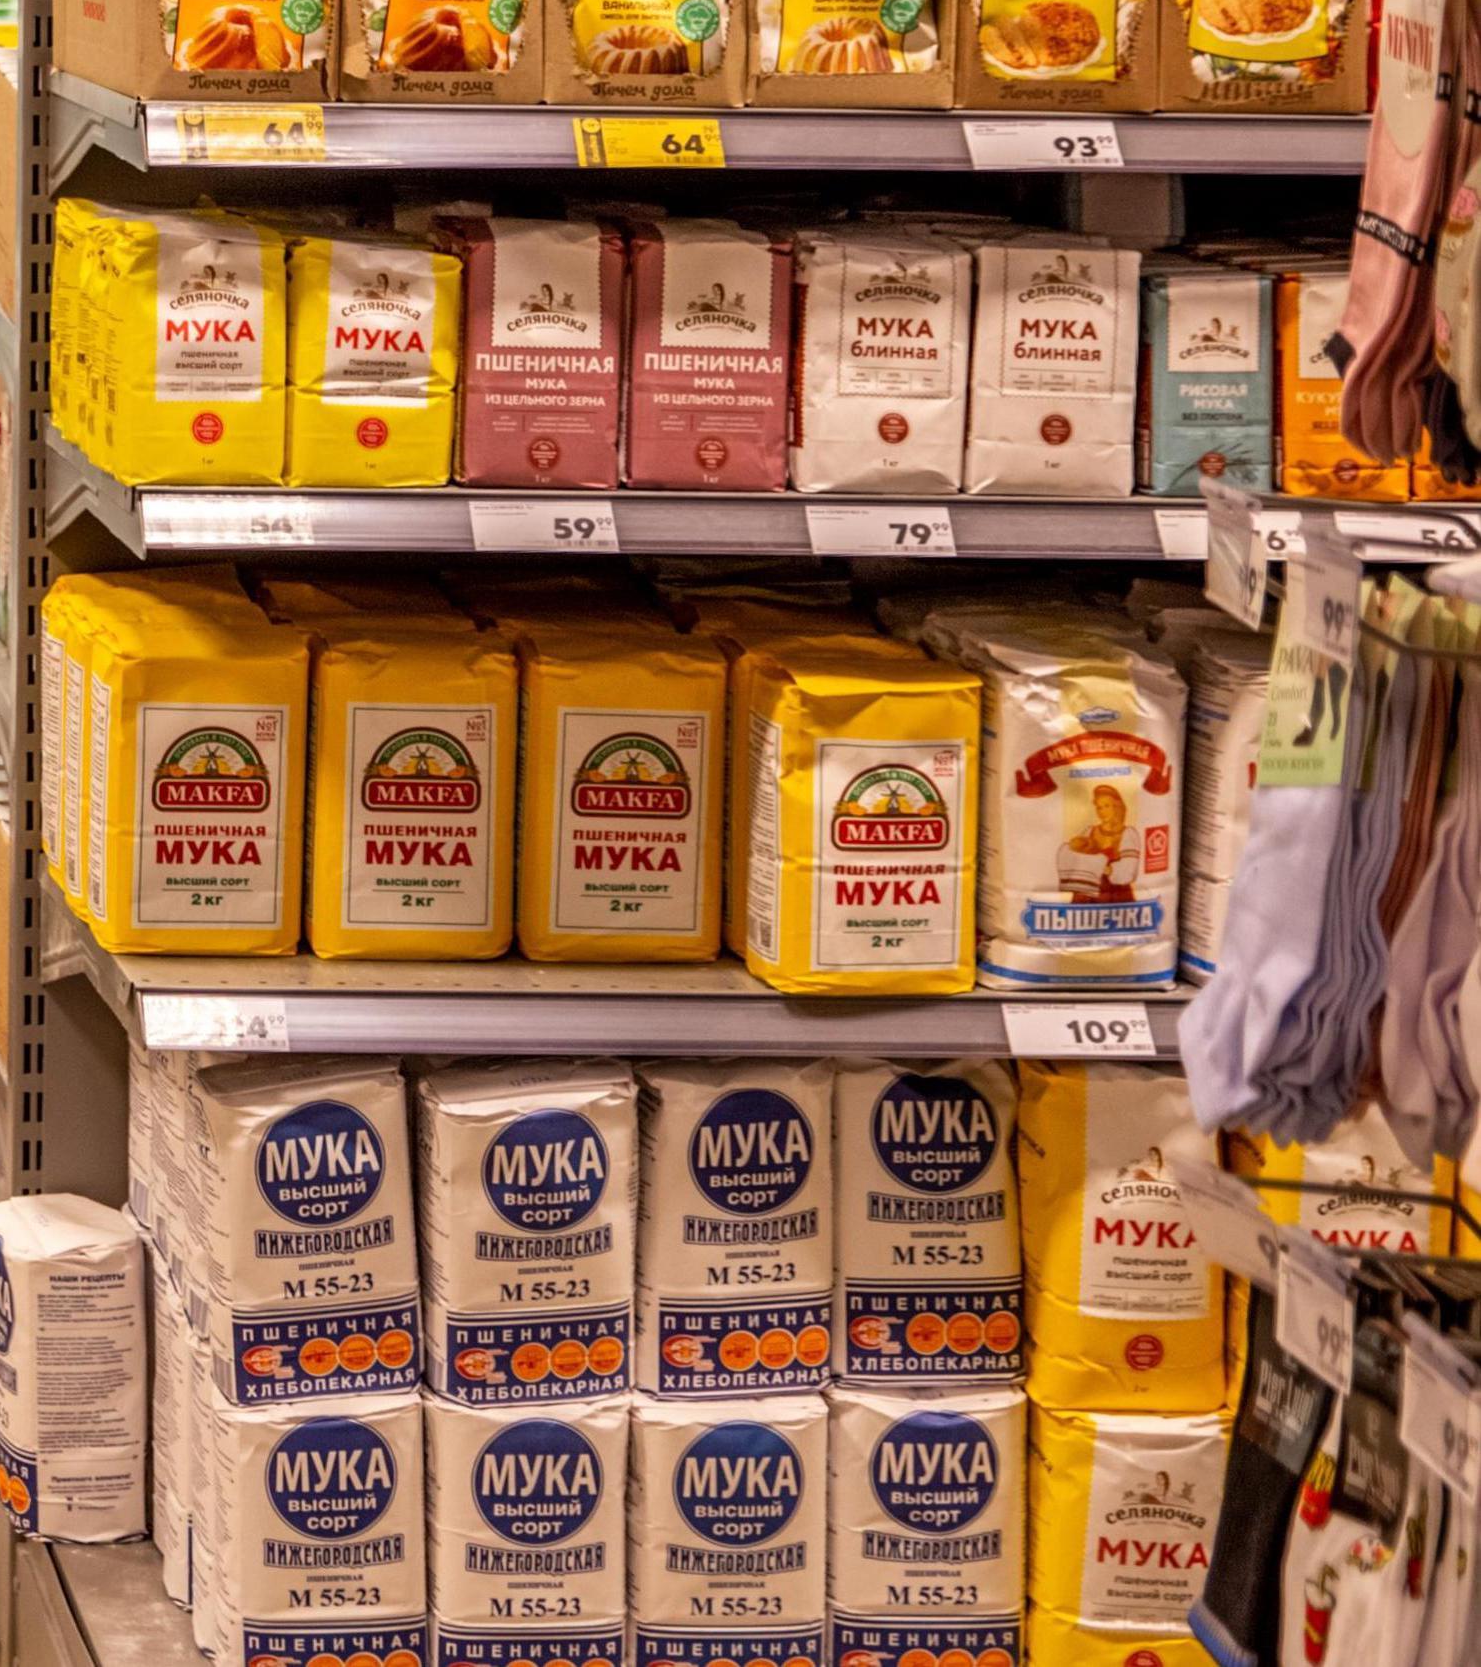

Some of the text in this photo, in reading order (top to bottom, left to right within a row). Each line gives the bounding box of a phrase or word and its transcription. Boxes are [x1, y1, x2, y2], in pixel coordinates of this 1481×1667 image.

[262, 122, 305, 147] 64
[661, 134, 705, 155] 64
[1053, 137, 1098, 159] 93
[169, 291, 250, 311] селяночка
[1018, 286, 1104, 306] селяночка
[341, 302, 423, 322] селяночка
[506, 312, 588, 333] селяночка
[166, 320, 255, 343] МУКА
[336, 326, 425, 353] МУКА
[1020, 319, 1098, 341] МУКА
[180, 350, 239, 359] пшеничная
[475, 353, 615, 374] ПШЕНИЧНАЯ
[1014, 343, 1102, 363] блинная
[175, 360, 243, 372] высший сорт
[525, 377, 567, 390] МУКА
[1179, 383, 1248, 398] РИСОВАЯ
[484, 394, 606, 407] ИЗ ЦЕЛЬНОГО ЗЕРНА
[1193, 398, 1235, 410] МУКА
[553, 518, 596, 539] 59
[889, 522, 932, 545] 79
[167, 785, 254, 803] MAKFA
[376, 785, 466, 803] MAKFA
[154, 825, 267, 837] ПШЕНИЧНАЯ
[845, 823, 937, 842] MAKFA
[155, 841, 261, 865] МУКА
[365, 841, 472, 866] МУКА
[166, 876, 250, 887] ВЫСШИЙ СОРТ
[835, 880, 941, 905] МУКА
[191, 893, 224, 909] 2 кг
[1034, 906, 1153, 930] ПЫШЕЧКА
[1067, 1021, 1130, 1044] 109
[880, 1098, 995, 1145] МУКА
[264, 1129, 382, 1183] МУКА
[491, 1136, 605, 1187] МУКА
[278, 1177, 369, 1202] высший
[298, 1199, 350, 1220] сорт
[684, 1209, 819, 1244] НИЖЕГОРОДСКАЯ
[256, 1219, 393, 1257] НИЖЕГОРОДСКАЯ
[314, 1273, 375, 1297] 55-23
[850, 1295, 1020, 1312] ПШЕНИЧНАЯ
[241, 1311, 414, 1341] ПШЕНИЧНАЯ
[245, 1367, 418, 1398] ХЛЕБОПЕКАРНАЯ
[664, 1366, 831, 1389] ХЛЕБОПЕКАРНАЯ
[275, 1448, 393, 1495] МУКА
[1105, 1507, 1207, 1531] селяночка
[264, 1536, 404, 1568] НИЖЕГОРОДСКАЯ
[1096, 1536, 1209, 1570] МУКА
[319, 1586, 382, 1608] 55-23
